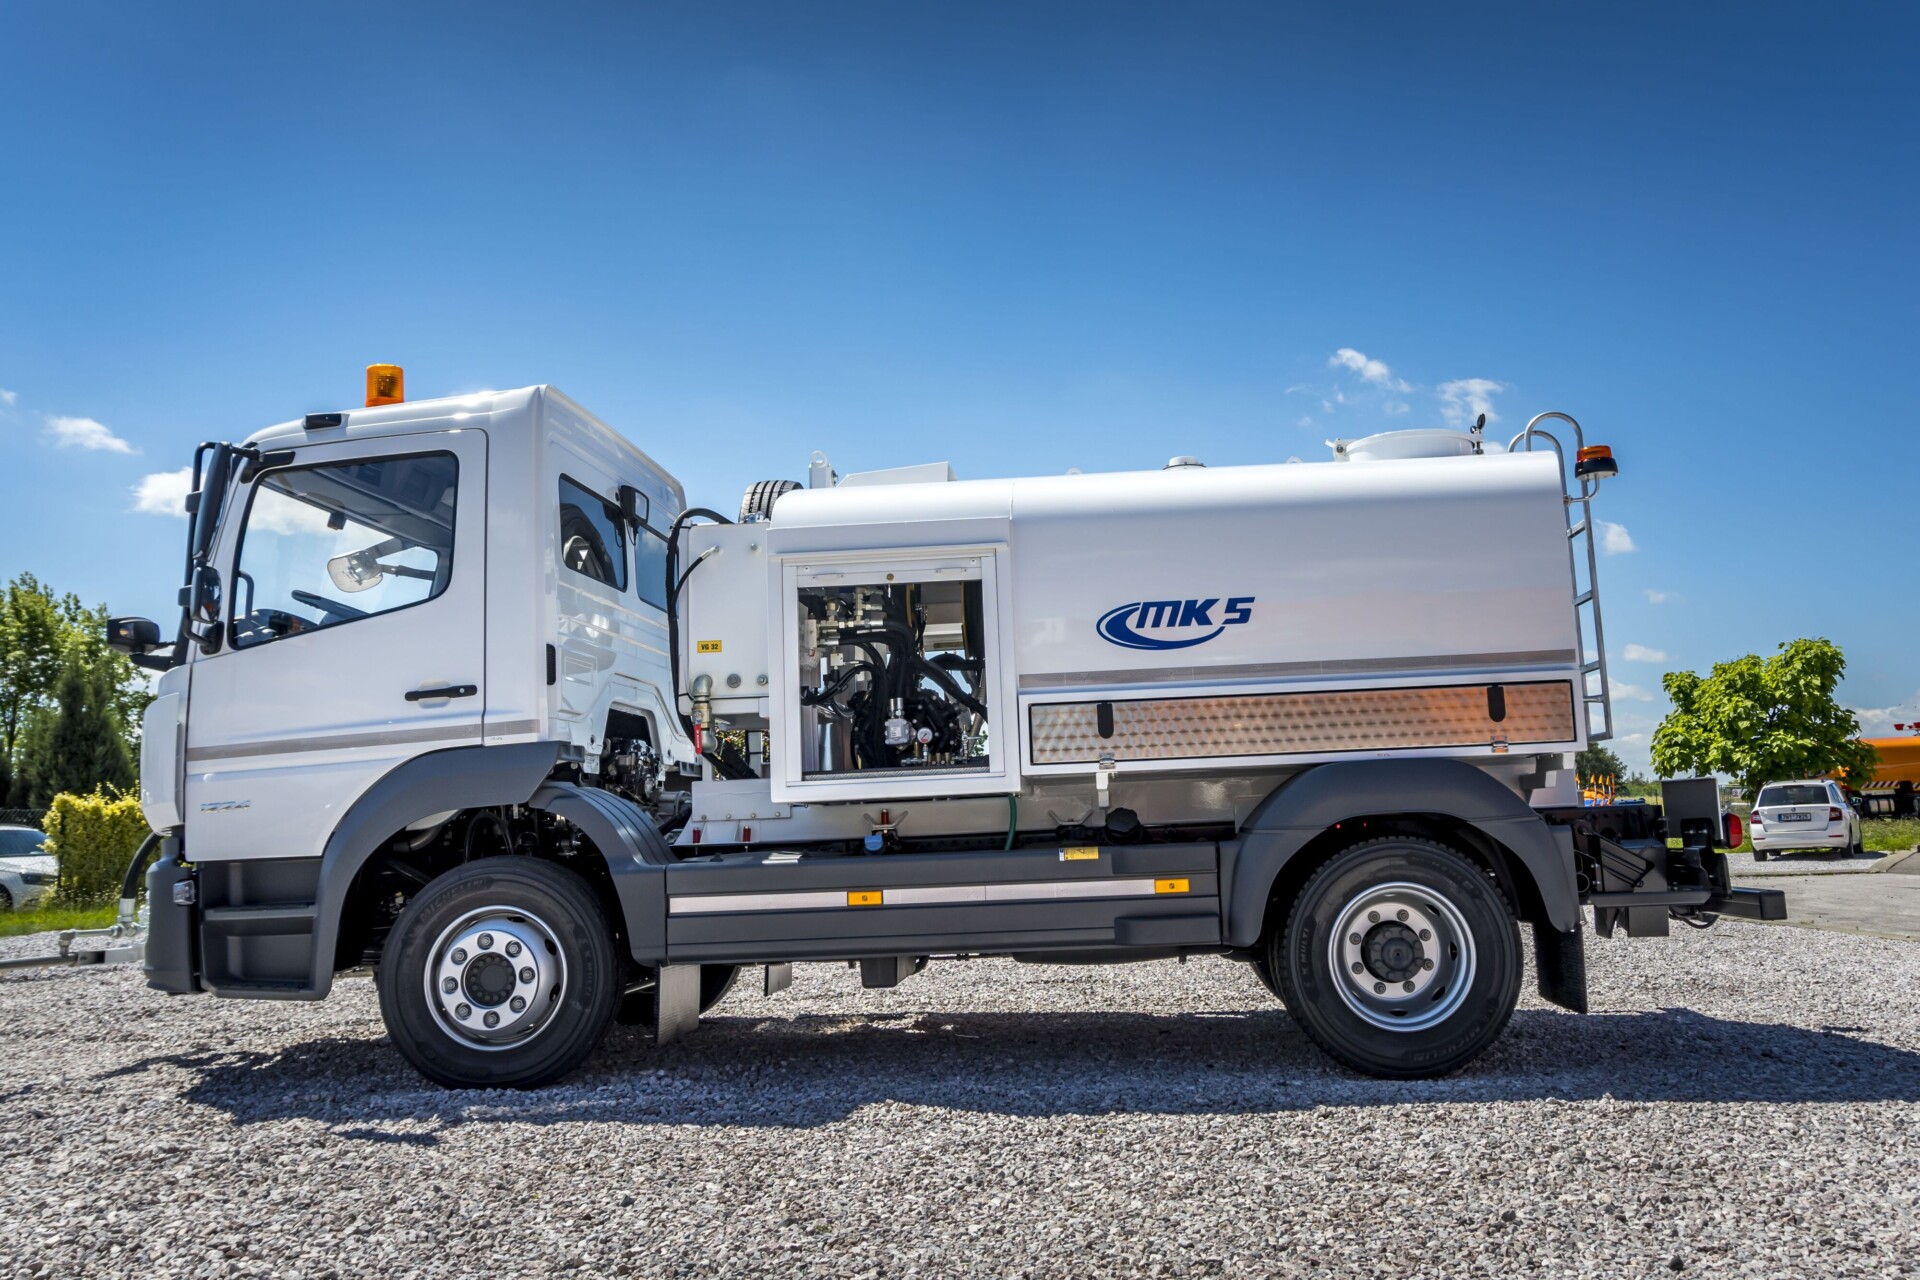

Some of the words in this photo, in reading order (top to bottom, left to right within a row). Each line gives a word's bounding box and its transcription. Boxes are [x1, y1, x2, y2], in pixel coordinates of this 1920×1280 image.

[1136, 598, 1220, 629] MK
[1222, 597, 1255, 625] 5
[1301, 927, 1309, 964] MULTI
